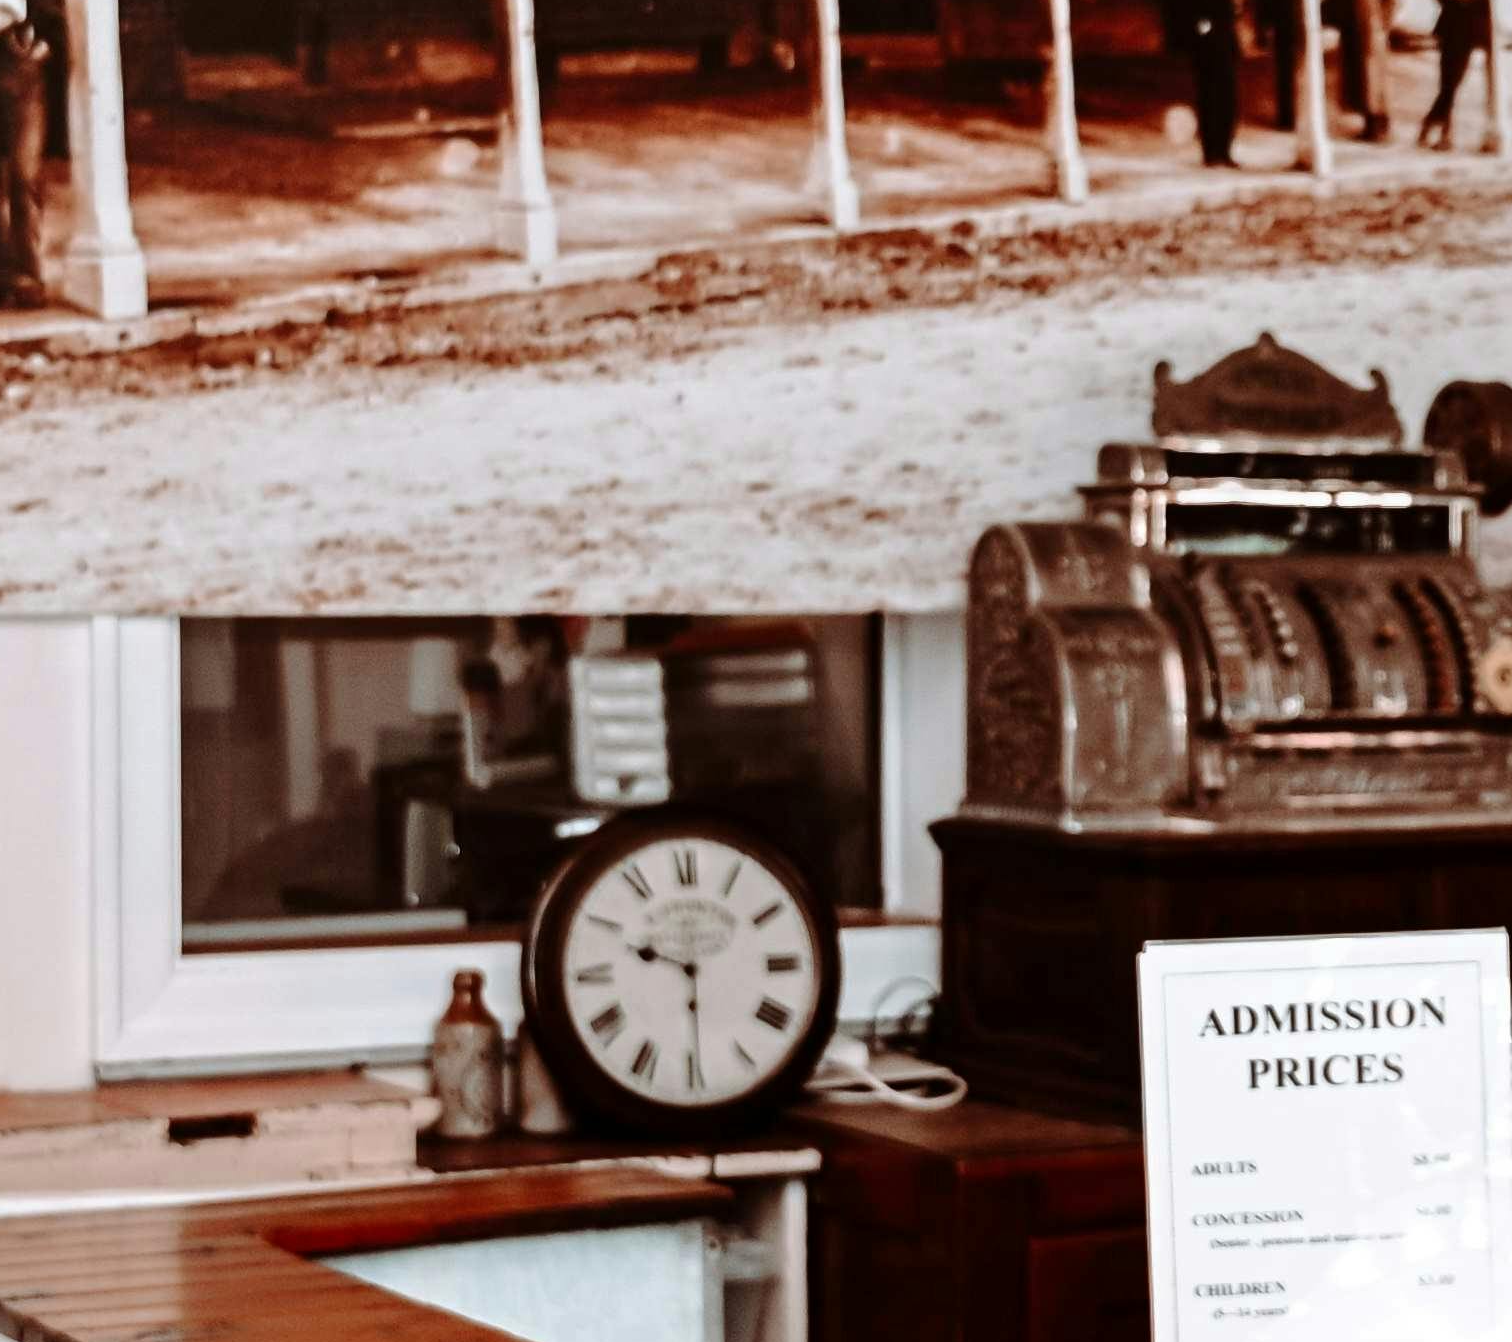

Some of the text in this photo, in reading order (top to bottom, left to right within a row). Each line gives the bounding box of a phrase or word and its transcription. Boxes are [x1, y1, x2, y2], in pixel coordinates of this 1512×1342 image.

[1197, 996, 1448, 1039] ADMISSION
[1247, 1053, 1405, 1090] PRICES
[1191, 1159, 1258, 1177] ADULTS
[1191, 1209, 1305, 1228] CONCESSION
[1192, 1280, 1287, 1298] CHILDREN
